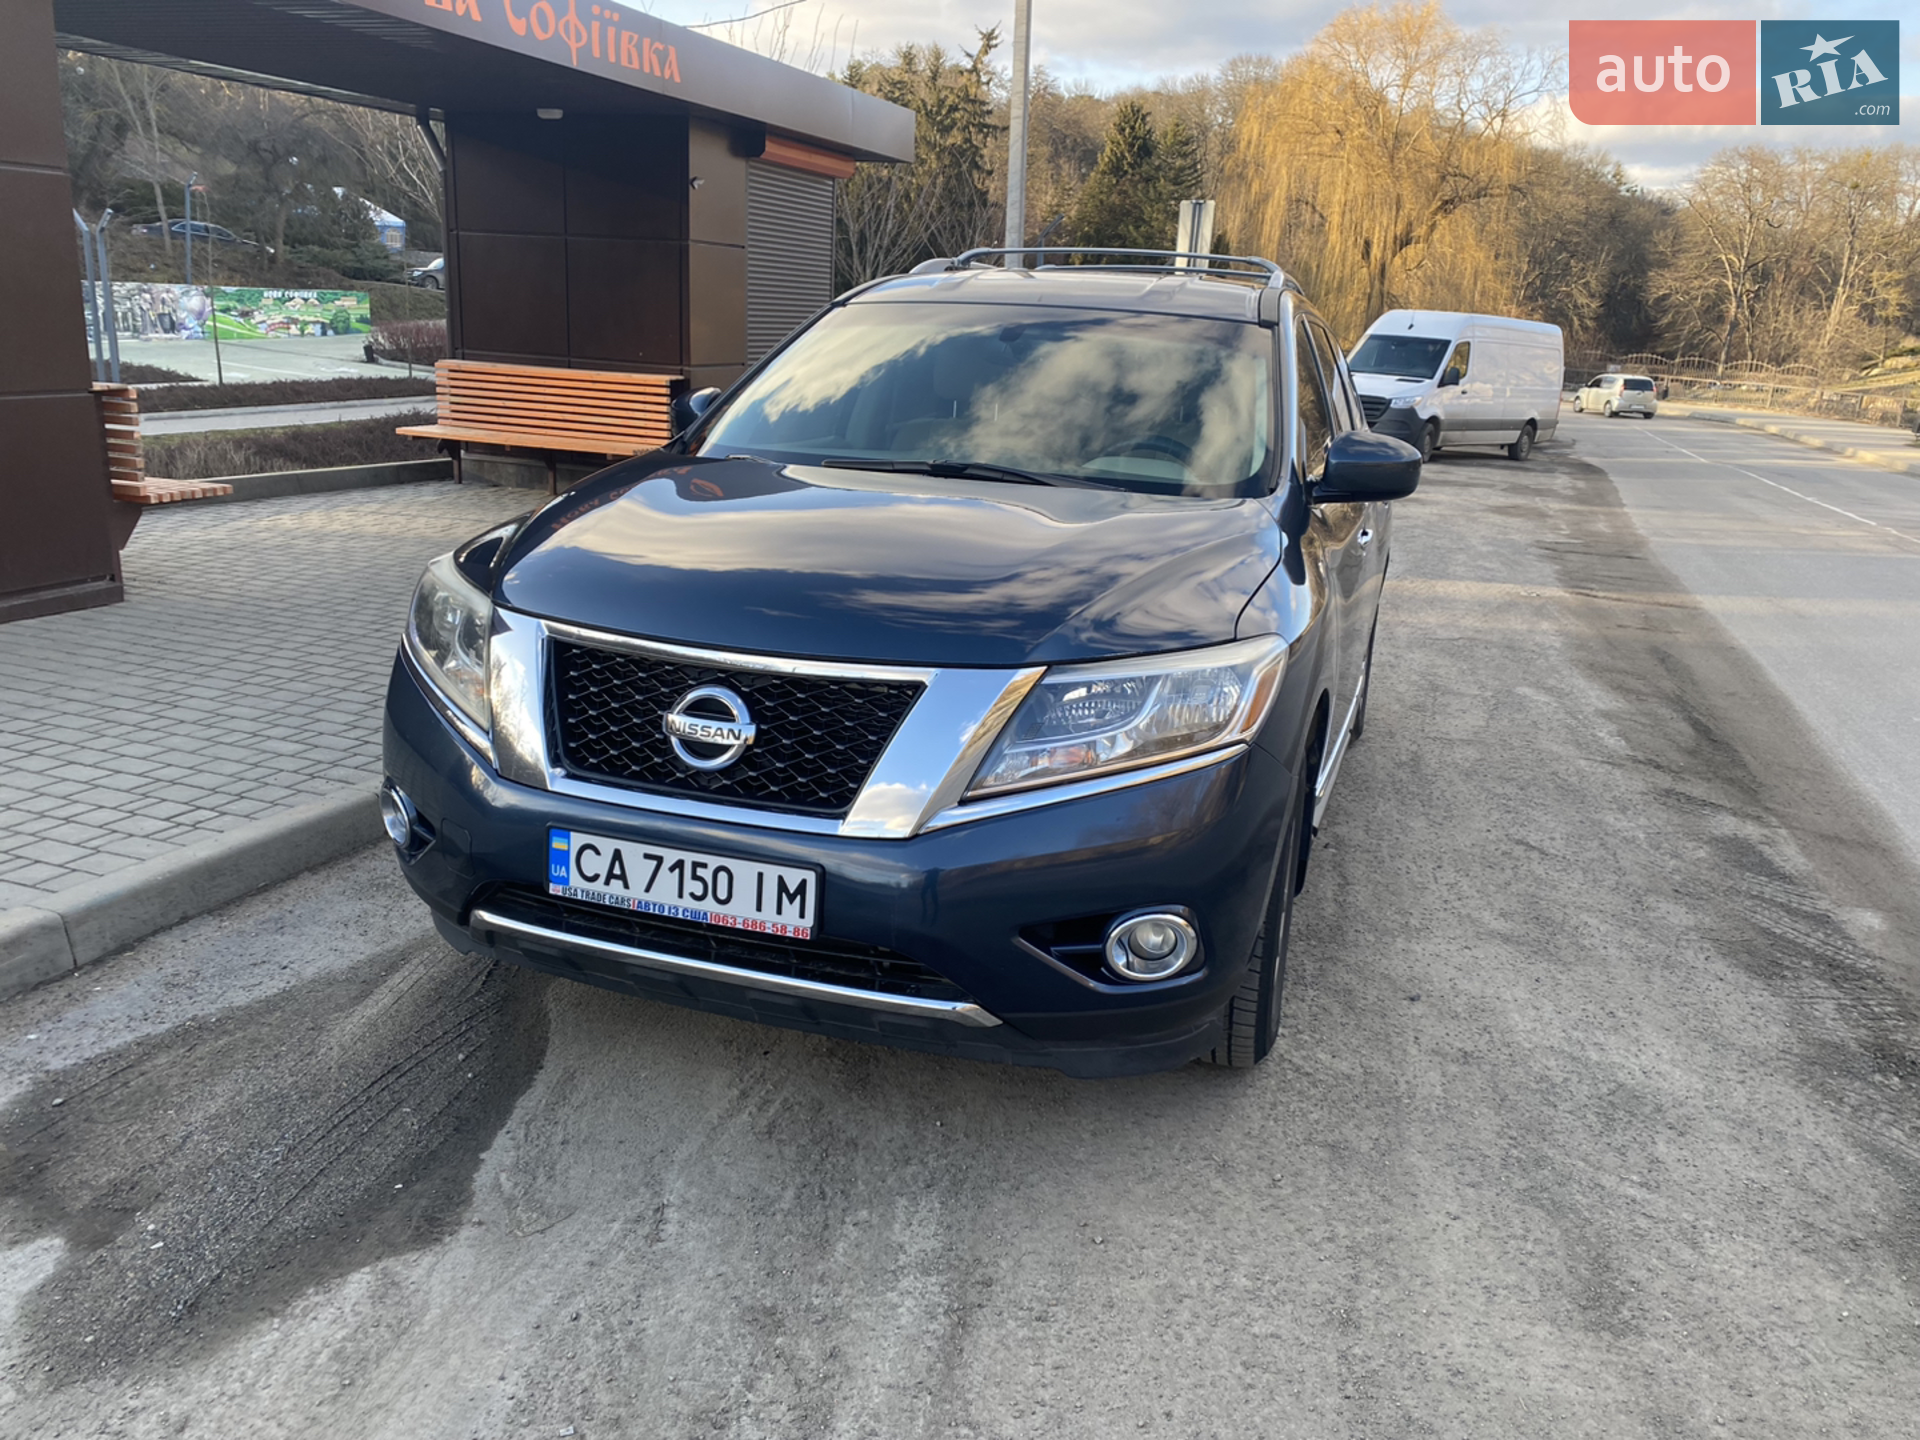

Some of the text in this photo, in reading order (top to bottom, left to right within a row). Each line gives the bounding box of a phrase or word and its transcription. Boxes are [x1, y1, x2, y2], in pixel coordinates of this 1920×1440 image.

[669, 719, 742, 741] NISSAN
[551, 863, 568, 879] UA
[575, 842, 630, 890] CA
[643, 852, 734, 906] 7150
[561, 885, 578, 898] USA
[580, 889, 607, 905] TRADE
